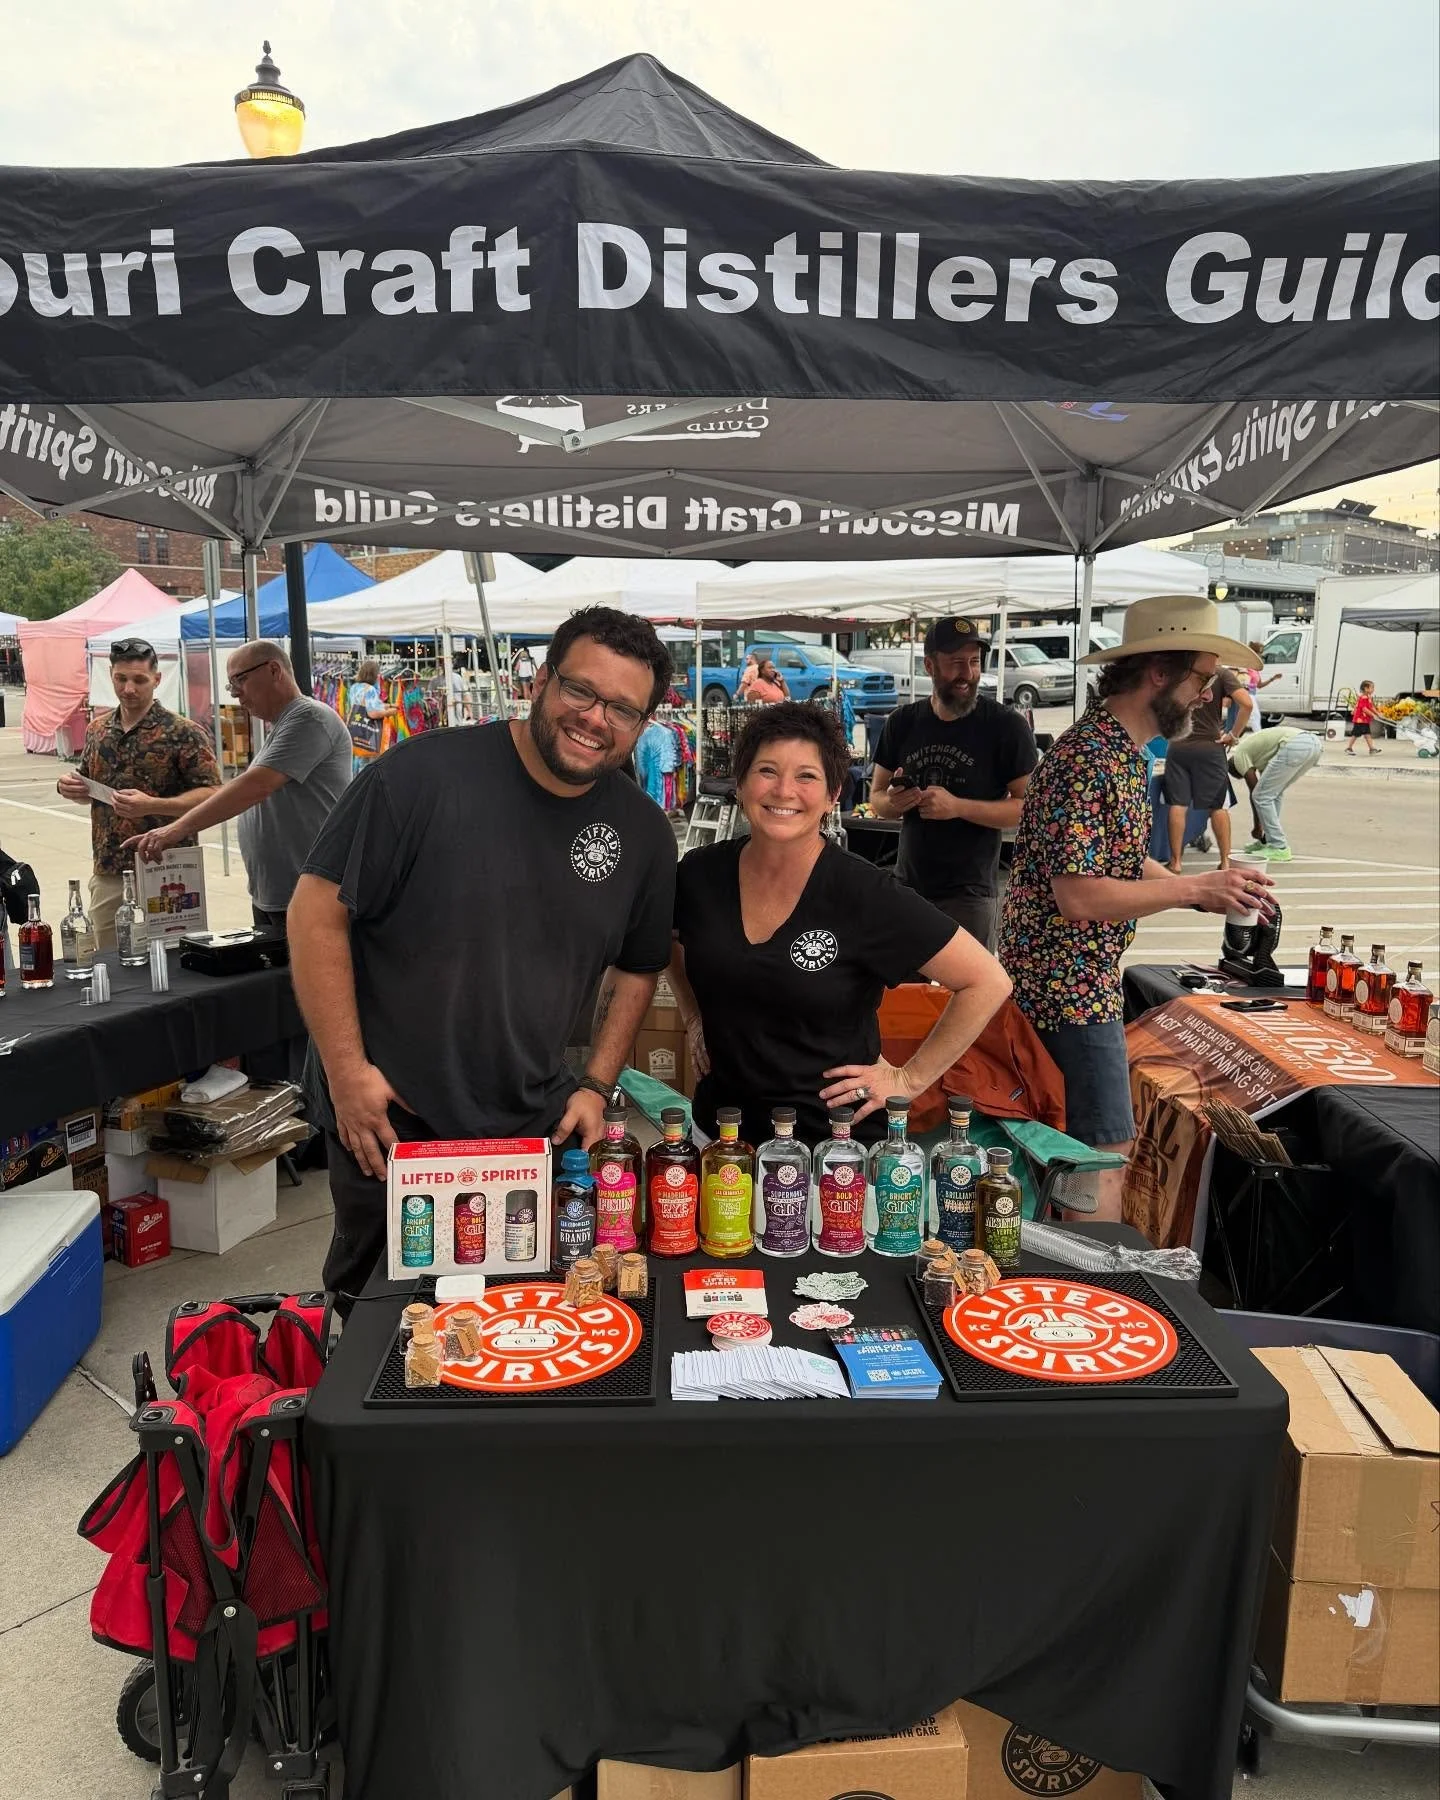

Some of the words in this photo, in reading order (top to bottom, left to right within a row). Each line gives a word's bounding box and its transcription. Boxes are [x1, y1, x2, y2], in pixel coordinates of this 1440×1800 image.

[227, 225, 532, 316] Craft
[577, 221, 1118, 325] Distillers
[906, 744, 975, 767] SWITCHGRASS
[917, 755, 957, 769] SPIRITS
[579, 826, 618, 850] LIFTED
[574, 853, 614, 878] SPIRITS
[796, 931, 834, 946] LIFTED
[793, 951, 833, 969] SPIRITS
[1152, 1013, 1182, 1032] MOST
[1183, 1014, 1237, 1053] HANDCRAFTING
[1284, 1036, 1397, 1081] 630
[401, 1172, 455, 1185] LIFTED
[481, 1168, 538, 1182] SPIRITS
[836, 1191, 853, 1199] BOLD
[889, 1192, 912, 1200] BRIGHT
[945, 1190, 977, 1200] BRILLIANT
[662, 1203, 689, 1213] RYE
[771, 1201, 802, 1216] GIN
[828, 1199, 859, 1213] GIN
[884, 1199, 915, 1213] GIN
[404, 1225, 430, 1237] GIN
[560, 1231, 591, 1242] BRANDY
[996, 1228, 1013, 1236] VERTE
[474, 1291, 614, 1323] IFTED
[964, 1286, 1129, 1320] LIFTED
[712, 1314, 755, 1324] LIFTED
[968, 1324, 991, 1332] KC
[1120, 1321, 1149, 1329] MO
[591, 1328, 618, 1337] MO
[976, 1332, 1157, 1373] SPIRITS
[890, 1727, 914, 1739] WITH
[916, 1726, 941, 1737] CARE
[1012, 1755, 1095, 1790] SPIRITS
